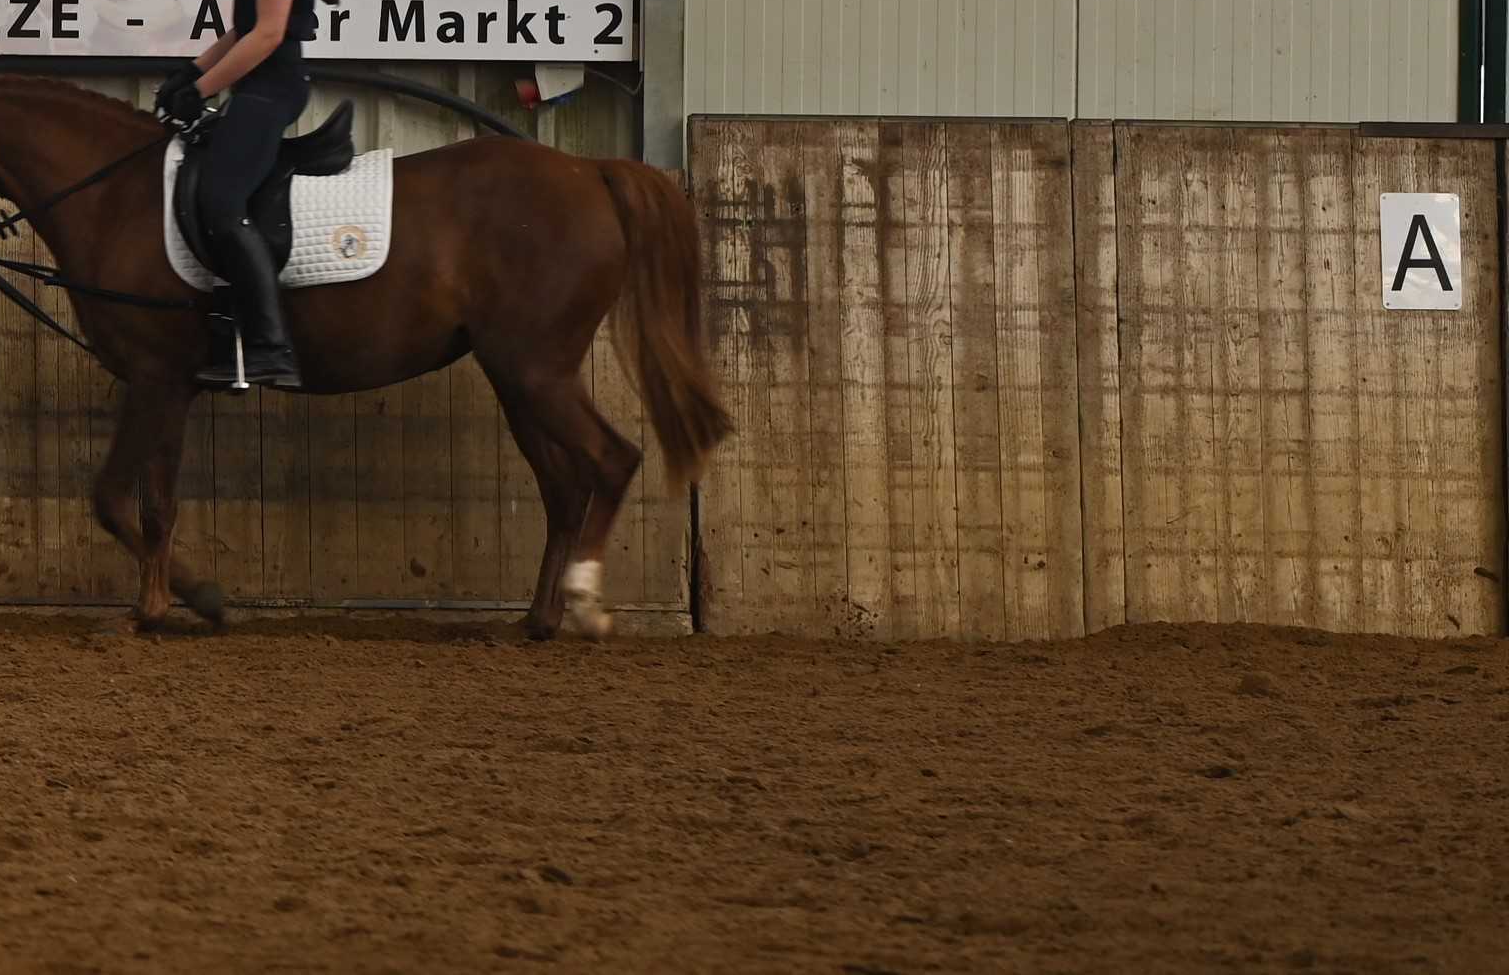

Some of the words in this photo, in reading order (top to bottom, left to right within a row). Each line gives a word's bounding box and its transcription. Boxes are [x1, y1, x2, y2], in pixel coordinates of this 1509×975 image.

[380, 0, 566, 45] Markt
[593, 3, 625, 45] 2
[1391, 214, 1453, 291] A
